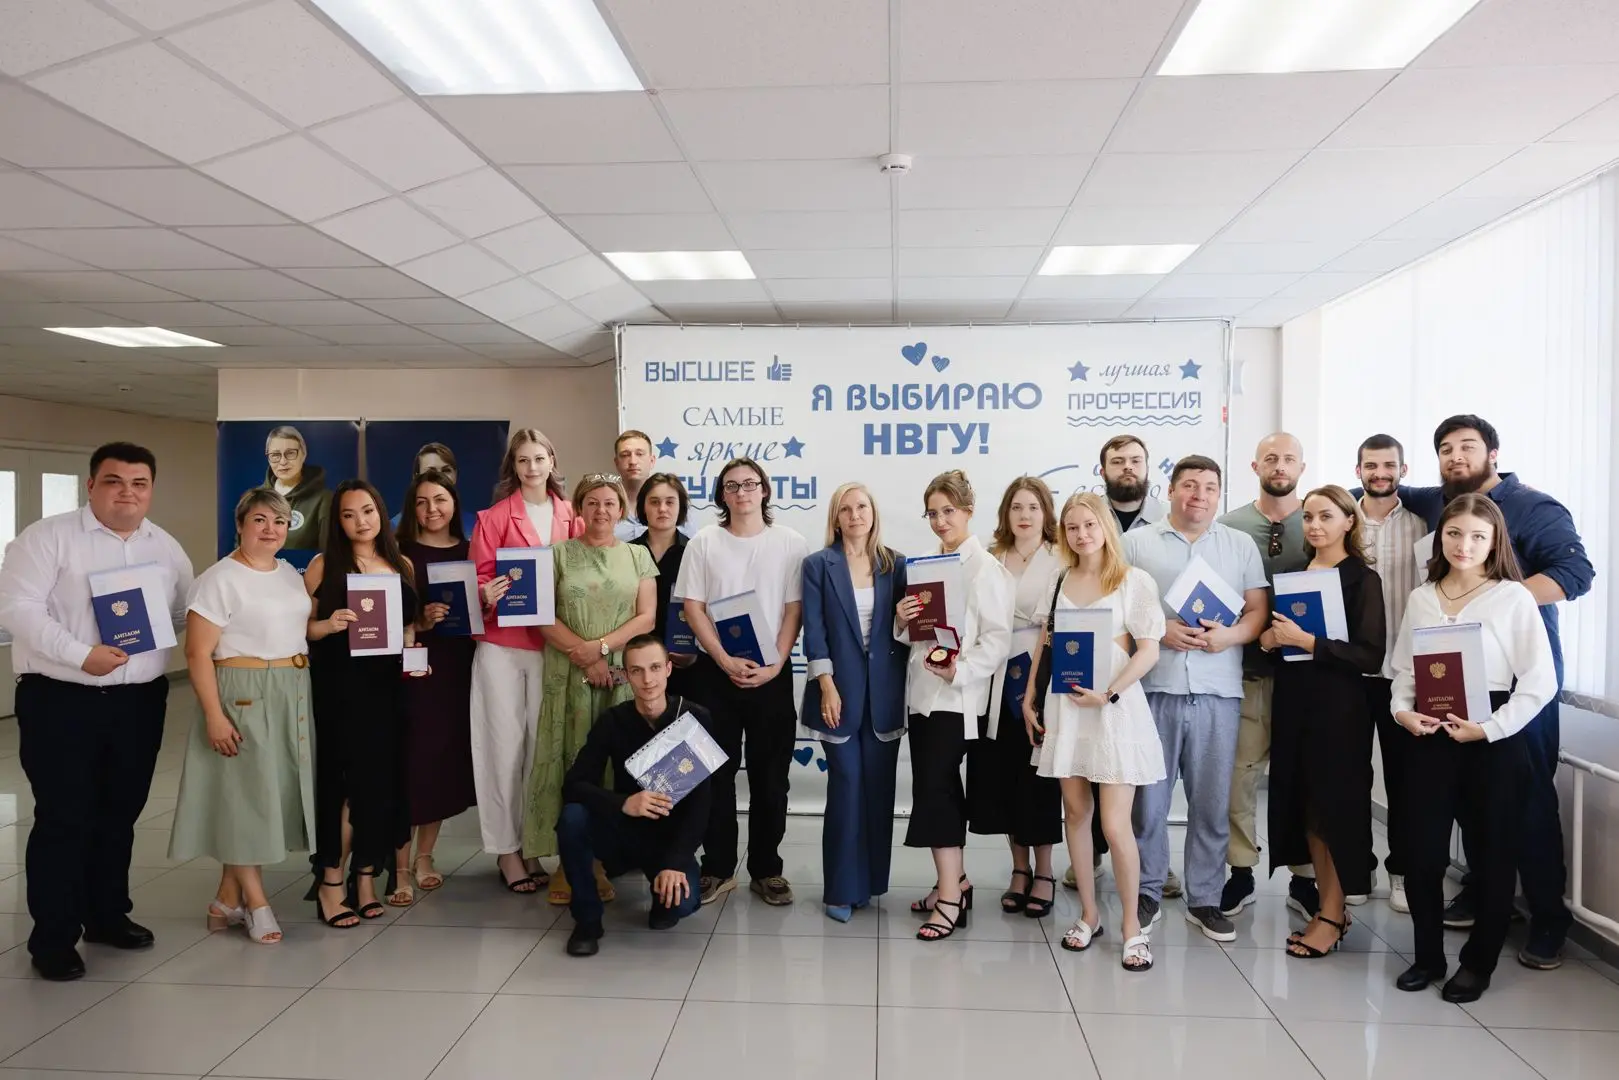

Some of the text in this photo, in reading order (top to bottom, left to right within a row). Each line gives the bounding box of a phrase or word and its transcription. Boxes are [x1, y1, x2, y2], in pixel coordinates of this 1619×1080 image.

[645, 361, 755, 382] ВЫСШЕЕ
[1099, 362, 1172, 386] лучшая
[812, 382, 1043, 411] Я ВЫБИРАЮ
[1068, 391, 1201, 410] ПРОФЕССИЯ
[682, 406, 784, 427] САМЫЕ
[863, 423, 990, 455] НВГУ!
[688, 440, 780, 476] яркие
[113, 629, 140, 640] ДИПЛОМ
